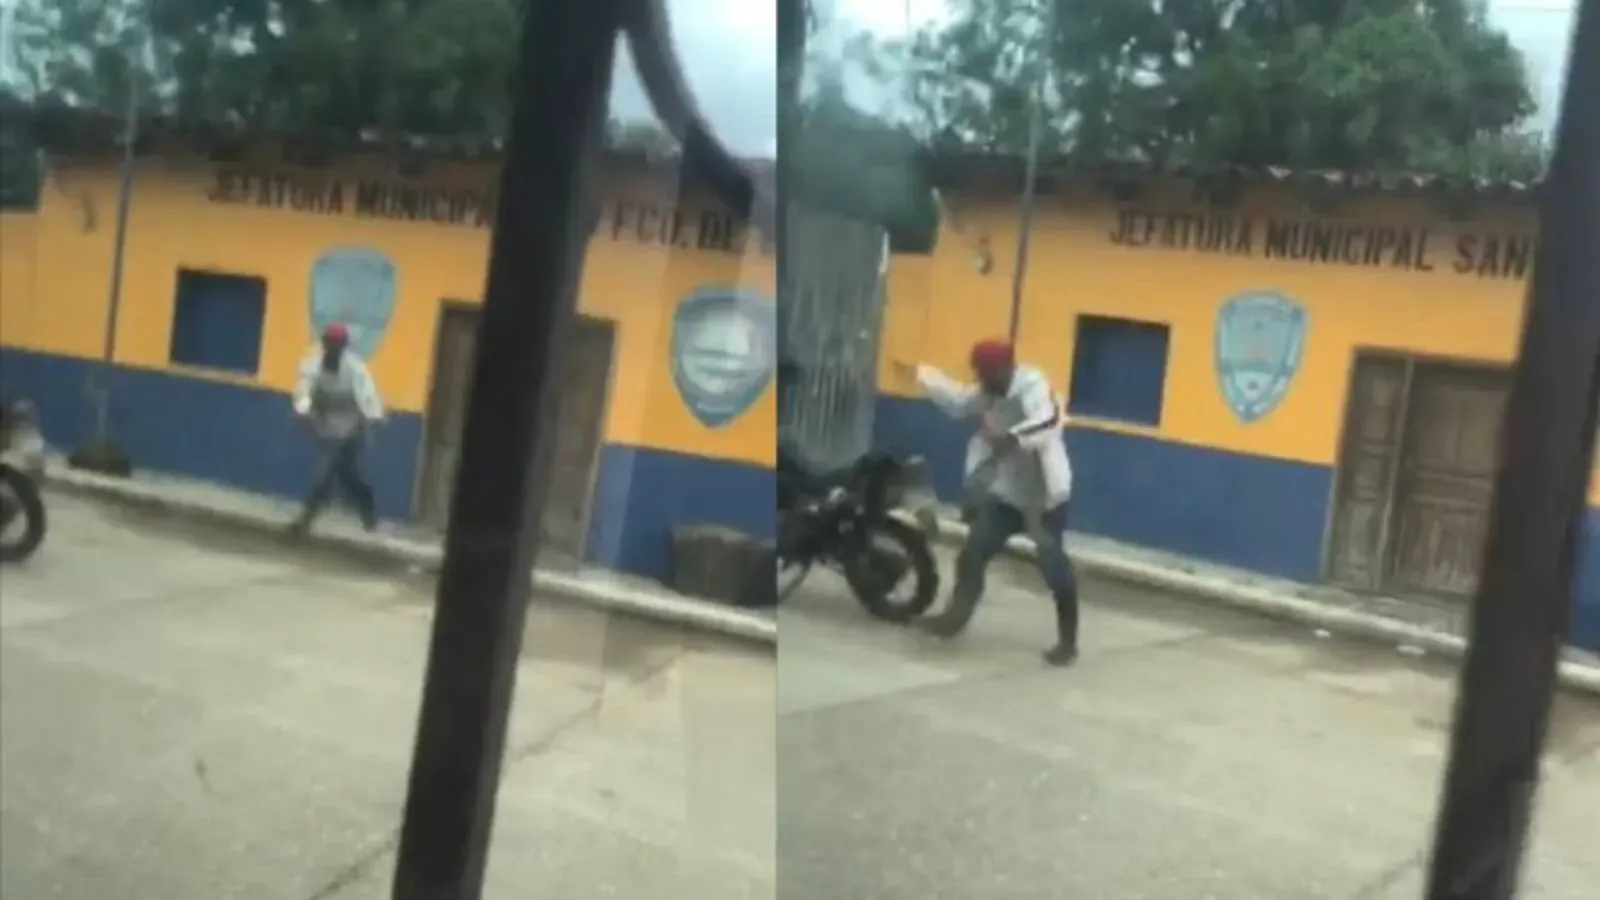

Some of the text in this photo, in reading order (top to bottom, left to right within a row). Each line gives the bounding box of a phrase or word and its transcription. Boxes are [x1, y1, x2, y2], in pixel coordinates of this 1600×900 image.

[207, 170, 344, 216] JEFATURA
[355, 180, 498, 229] MUNICIPA
[1109, 209, 1529, 280] JEFATURA MUNICIPAL SAN
